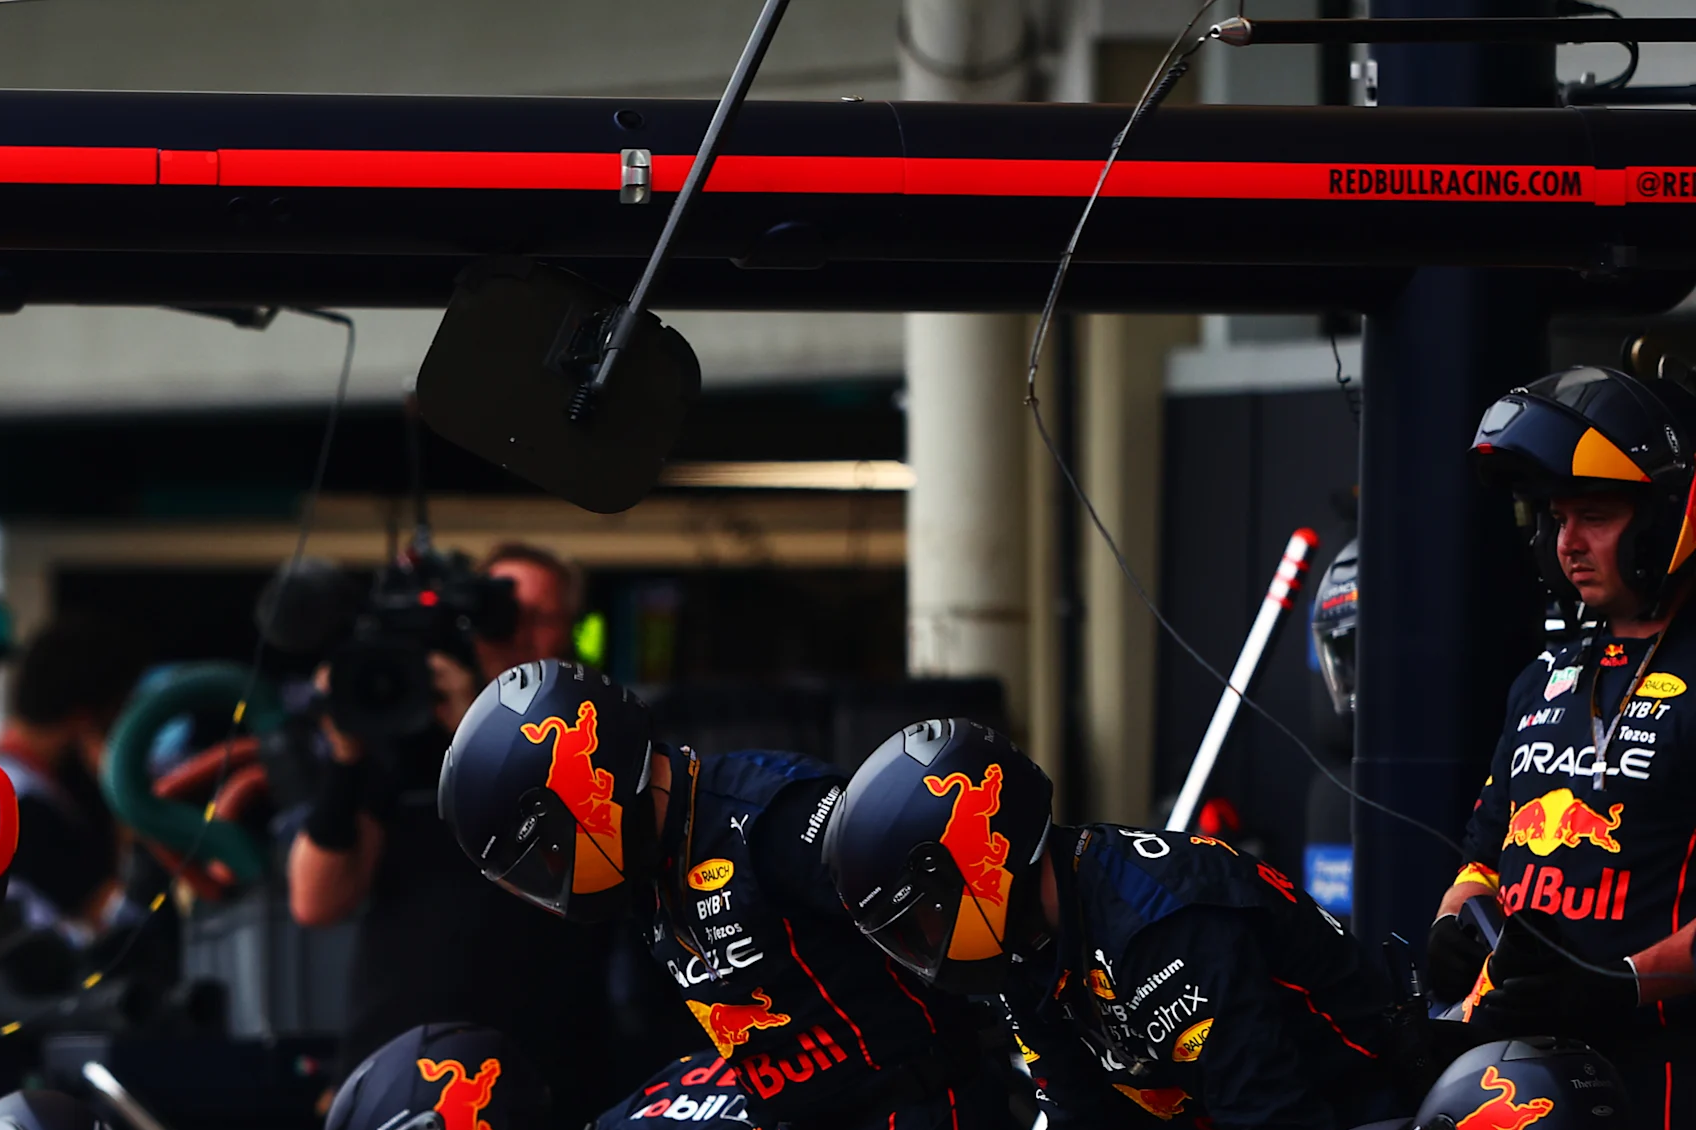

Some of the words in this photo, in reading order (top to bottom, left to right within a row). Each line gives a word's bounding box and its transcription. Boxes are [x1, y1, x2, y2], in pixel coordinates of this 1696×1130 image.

[1329, 169, 1582, 196] REDBULLRACING.COM
[1643, 681, 1679, 693] RAUCH
[1619, 725, 1656, 744] Tezos
[702, 865, 730, 884] RAUCH
[697, 888, 732, 920] BYBIT
[1530, 866, 1631, 920] Bull
[667, 936, 764, 988] ACLE
[1183, 1026, 1212, 1054] RAUC
[741, 1024, 848, 1100] Bull
